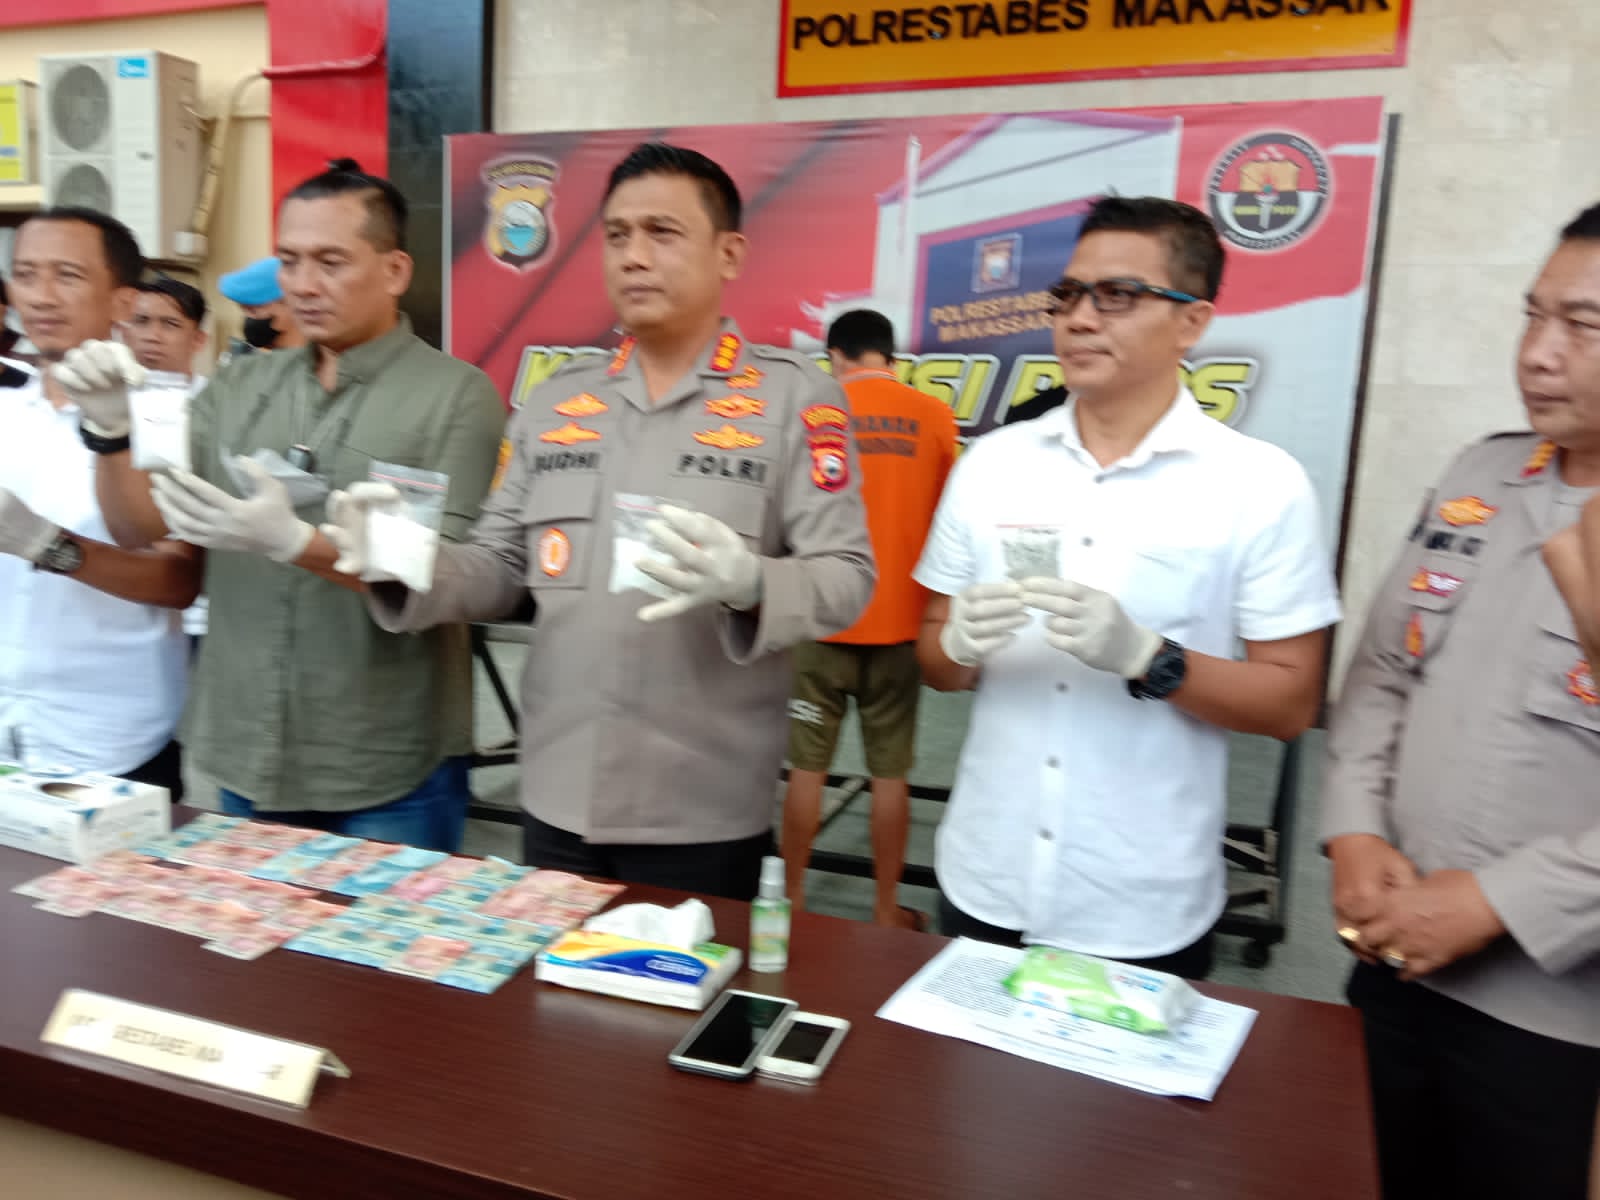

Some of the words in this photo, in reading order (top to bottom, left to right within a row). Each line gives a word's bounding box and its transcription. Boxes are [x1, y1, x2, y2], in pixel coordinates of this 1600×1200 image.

[793, 0, 1090, 50] POLRESTABES
[930, 290, 1058, 326] POLRESTABE
[677, 453, 768, 483] POLRI
